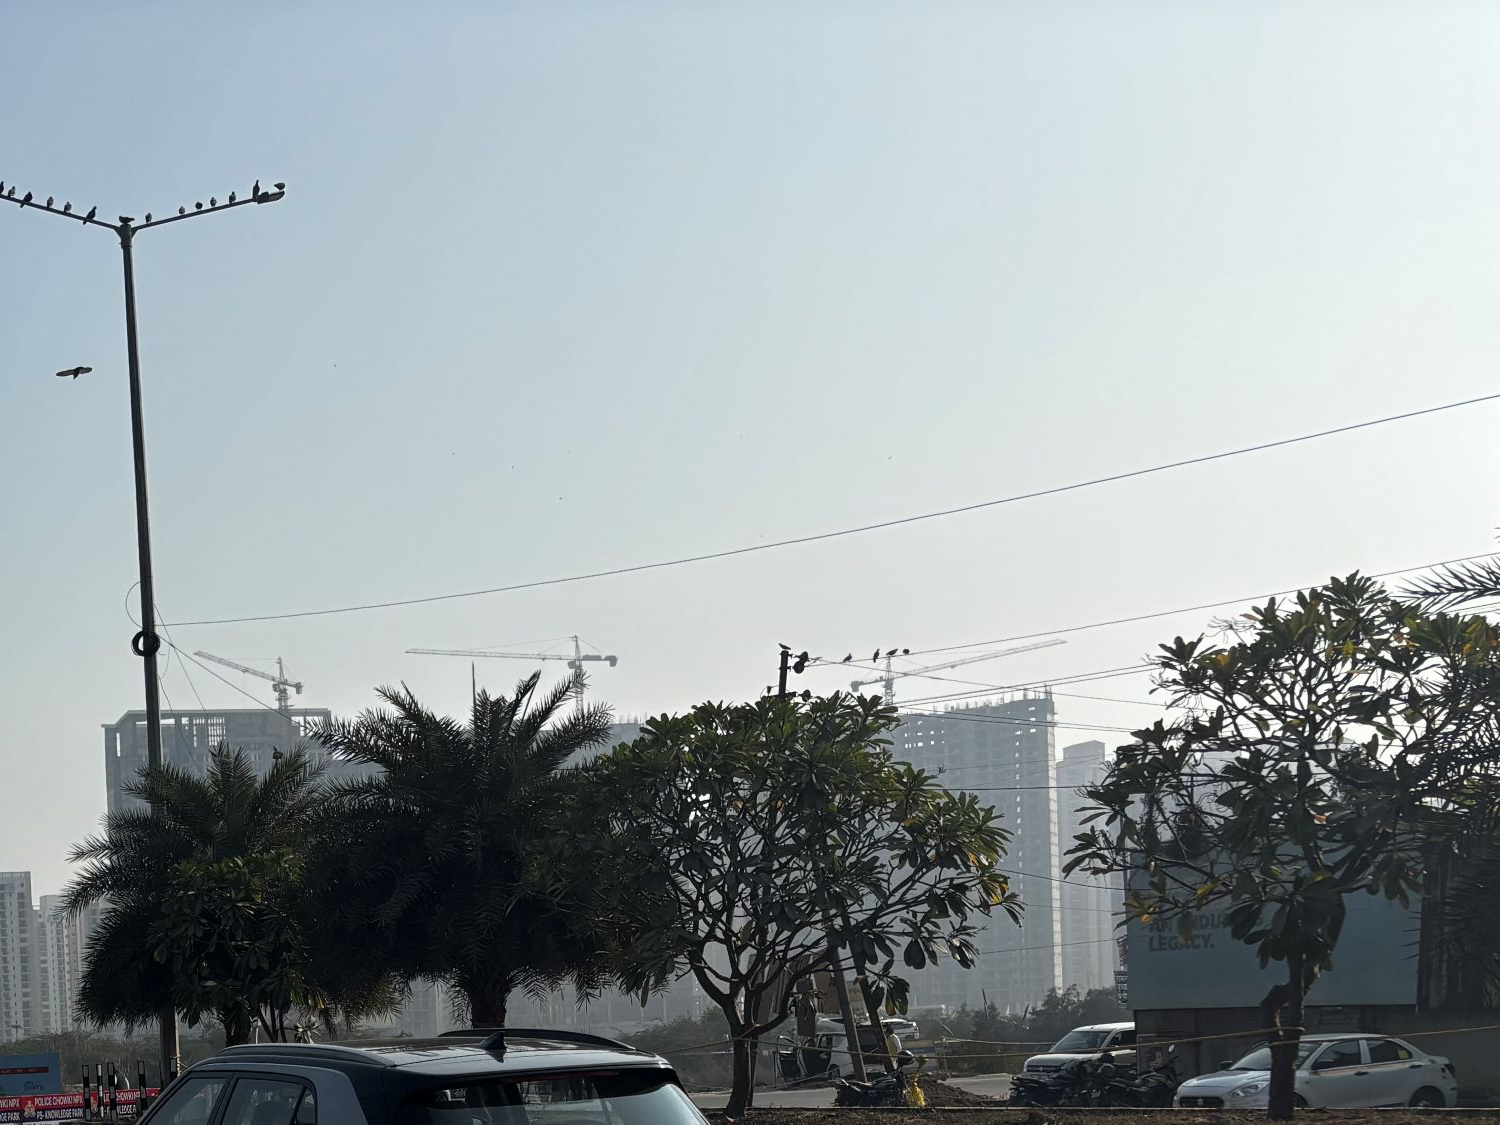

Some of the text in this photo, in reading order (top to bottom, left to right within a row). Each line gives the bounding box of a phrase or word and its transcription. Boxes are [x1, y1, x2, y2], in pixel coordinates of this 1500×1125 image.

[8, 1098, 20, 1107] NPX
[34, 1095, 84, 1106] POLICE CHOWKI NPX
[7, 1111, 21, 1122] PARK
[44, 1109, 72, 1119] KNOWLEDGE
[72, 1108, 84, 1117] PARK
